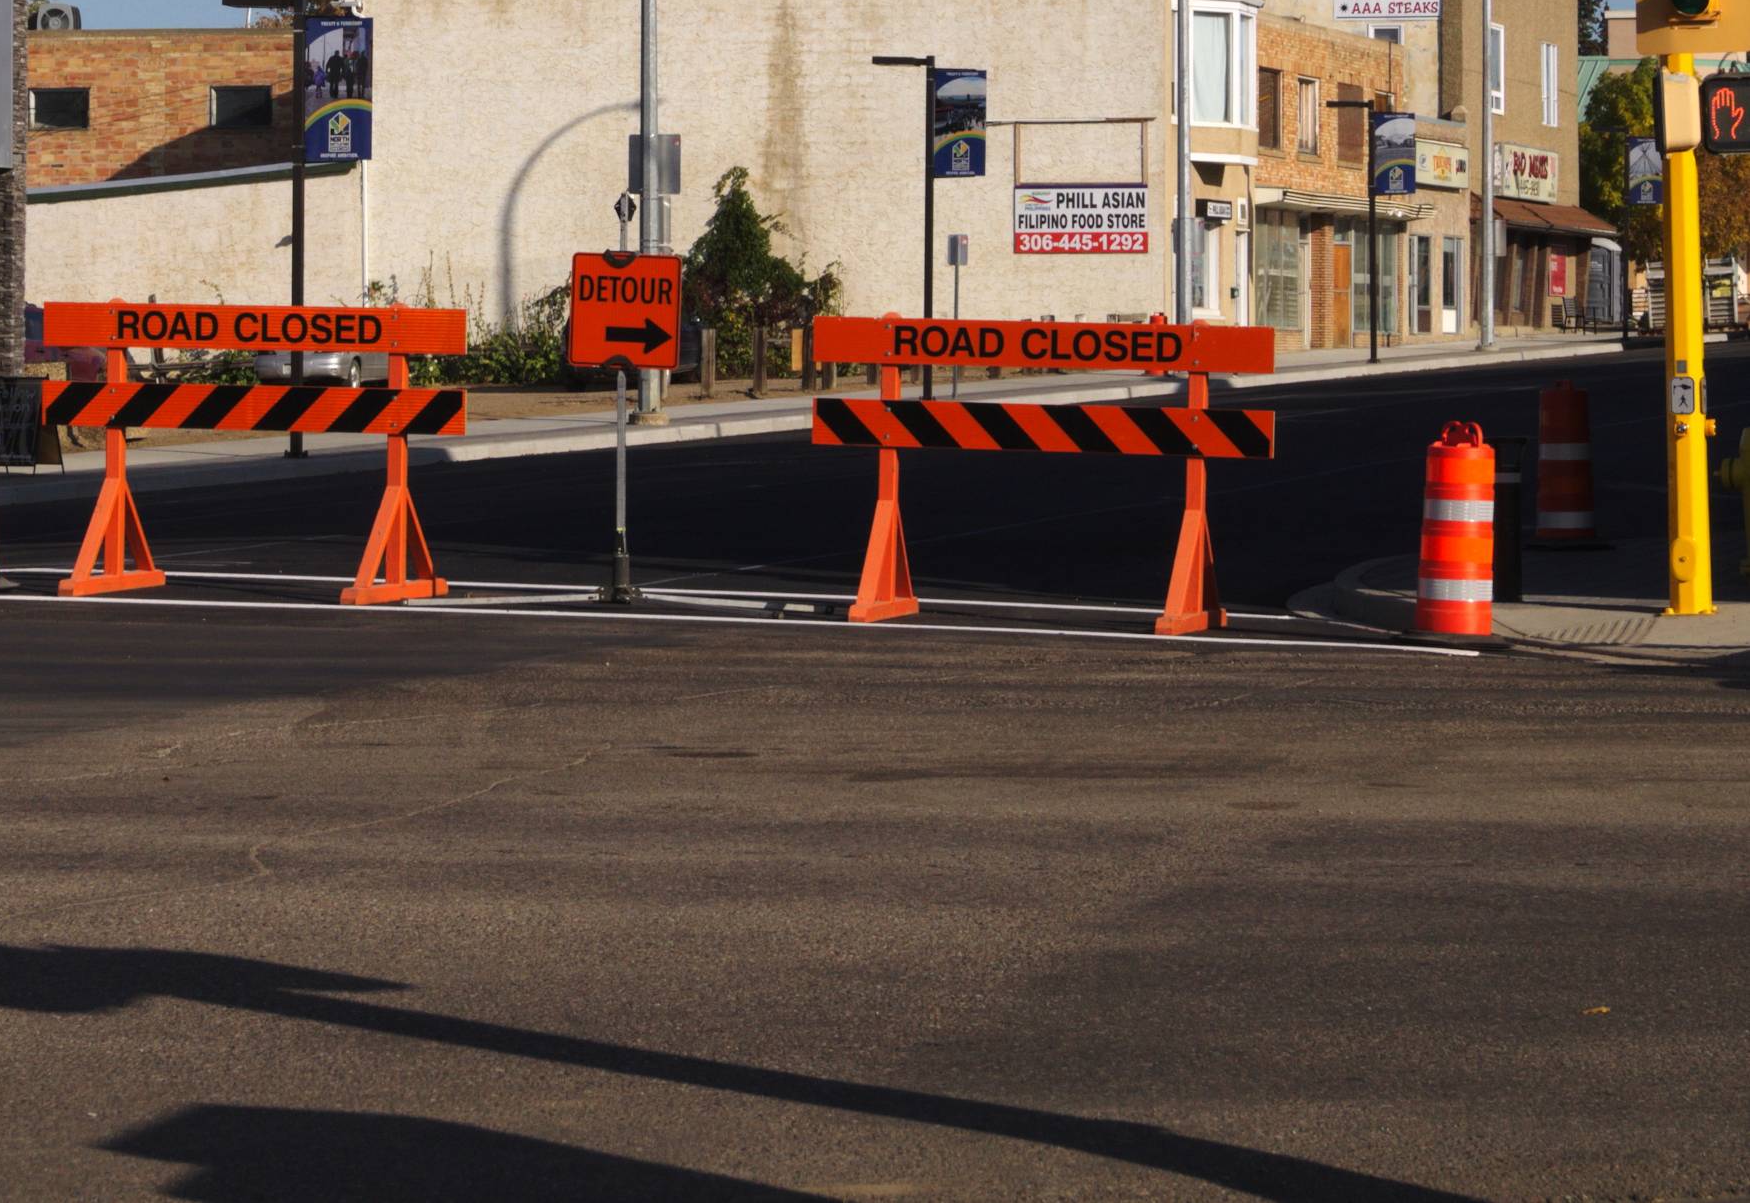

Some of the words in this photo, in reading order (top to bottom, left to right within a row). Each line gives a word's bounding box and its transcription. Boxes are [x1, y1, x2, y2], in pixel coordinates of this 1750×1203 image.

[1351, 2, 1382, 14] AAA
[1388, 1, 1439, 14] STEAKS
[1056, 192, 1098, 209] PHILL
[1102, 192, 1146, 209] ASIAN
[1018, 214, 1068, 229] FILIPINO
[1071, 214, 1103, 229] FOOD
[1107, 213, 1146, 229] STORE
[1019, 233, 1144, 251] 306-445-1292
[579, 275, 673, 305] DETOUR
[116, 310, 219, 342] ROAD
[234, 312, 383, 346] CLOSED
[893, 325, 1005, 359] ROAD
[1020, 327, 1183, 364] CLOSED
